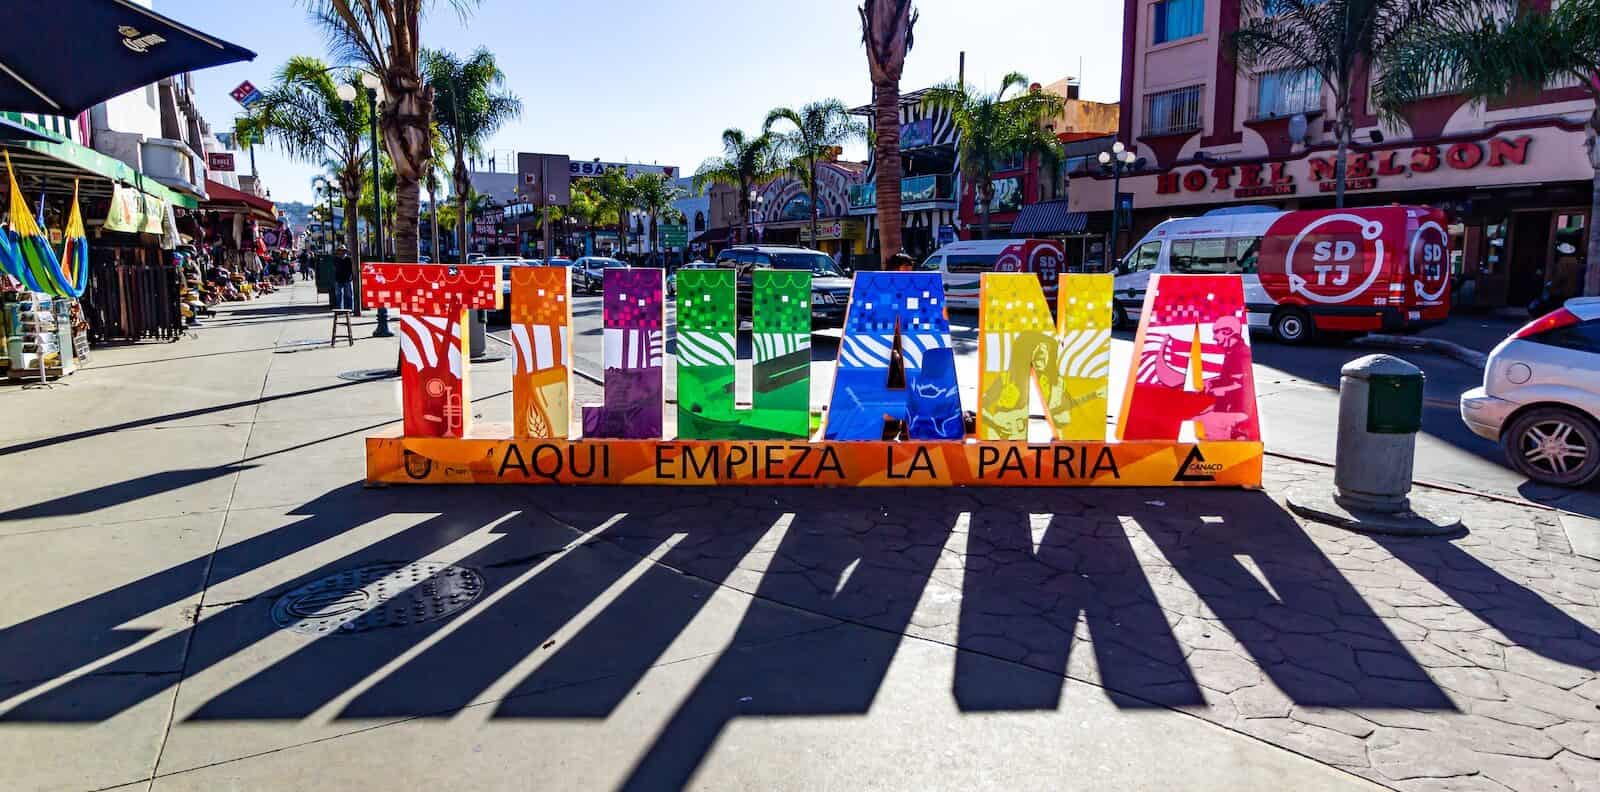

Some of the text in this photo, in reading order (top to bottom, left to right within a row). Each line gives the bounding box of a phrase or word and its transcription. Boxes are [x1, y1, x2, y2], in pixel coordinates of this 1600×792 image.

[1156, 135, 1533, 195] HOTEL NELSON
[1039, 256, 1057, 268] SD
[1312, 240, 1357, 262] SD
[1423, 243, 1442, 262] SD
[1313, 264, 1351, 286] TJ
[362, 263, 1261, 442] TIJUANA
[498, 443, 1121, 482] AQUI EMPIEZA LA PATRIA
[1189, 463, 1224, 472] CANACO
